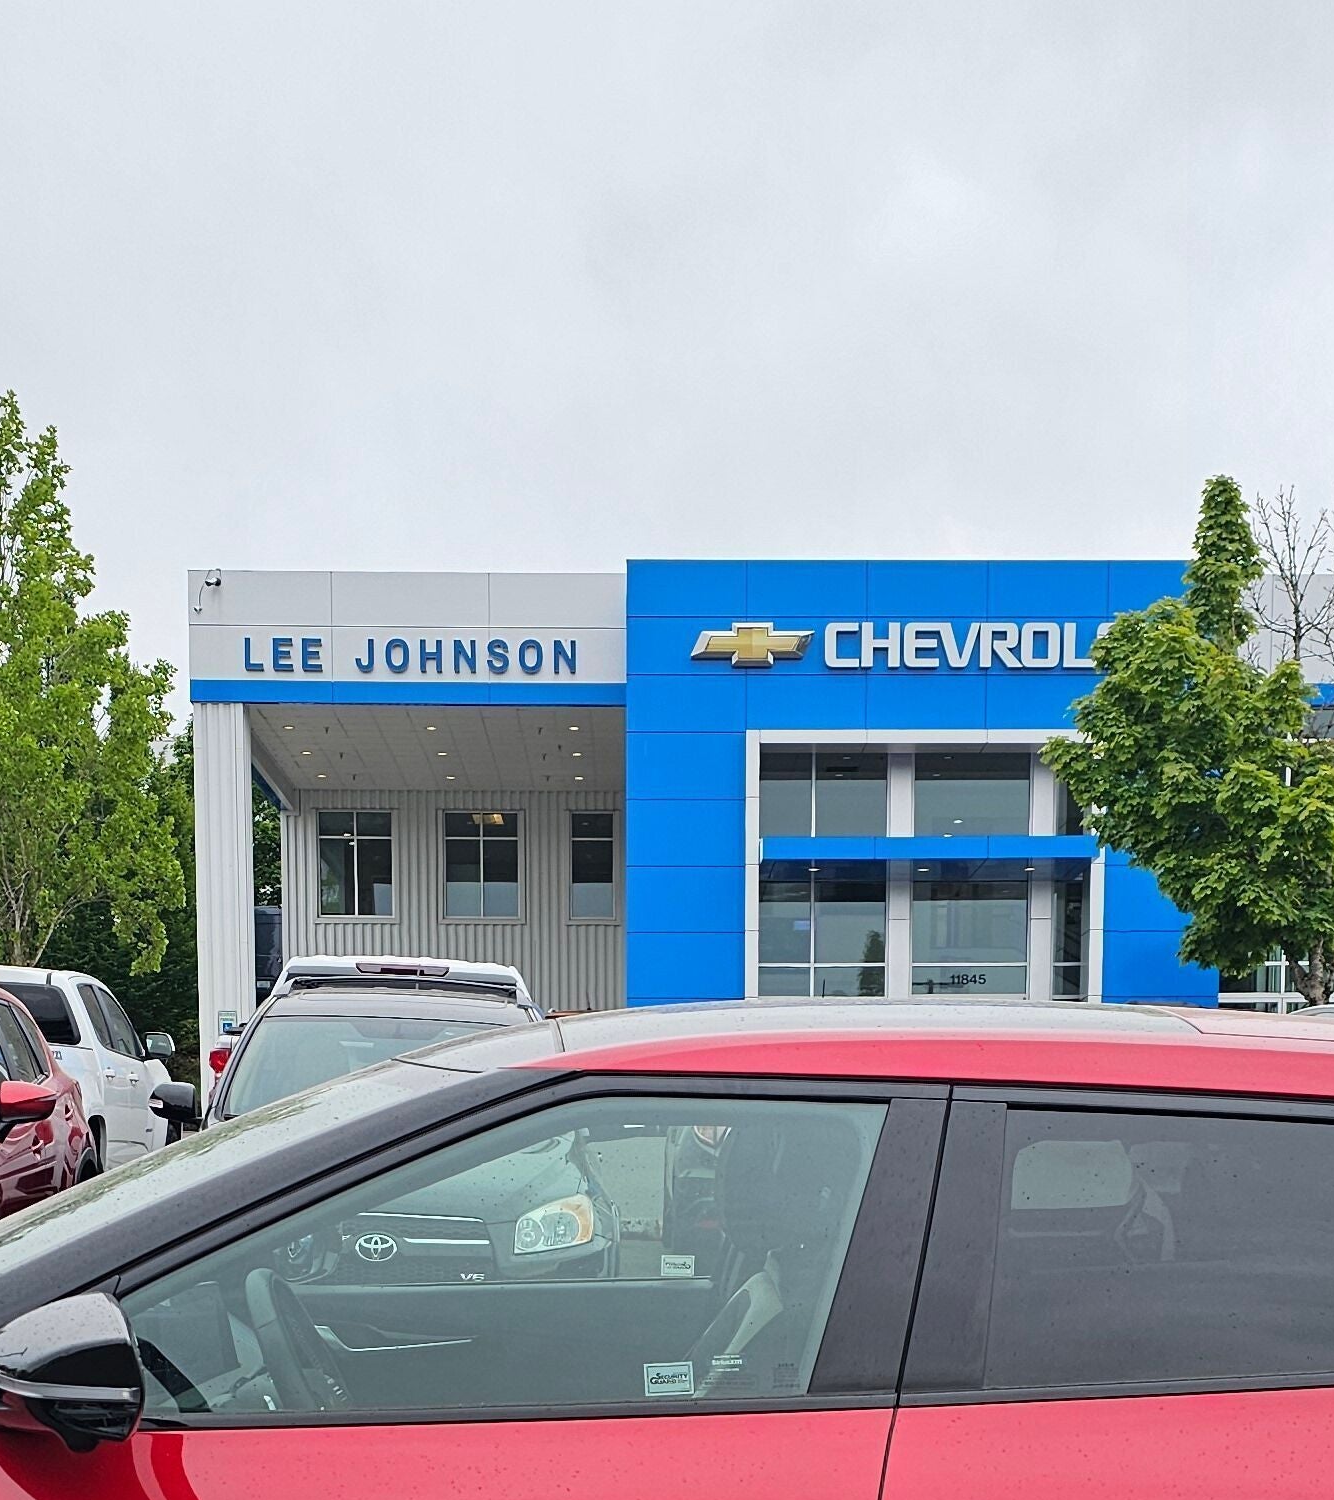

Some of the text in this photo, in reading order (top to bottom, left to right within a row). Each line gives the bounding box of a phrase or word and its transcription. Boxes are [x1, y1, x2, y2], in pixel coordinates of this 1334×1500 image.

[244, 637, 578, 675] LEE JOHNSON
[824, 621, 1115, 668] CHEVROL
[949, 973, 987, 985] 11845
[459, 1273, 485, 1282] V6
